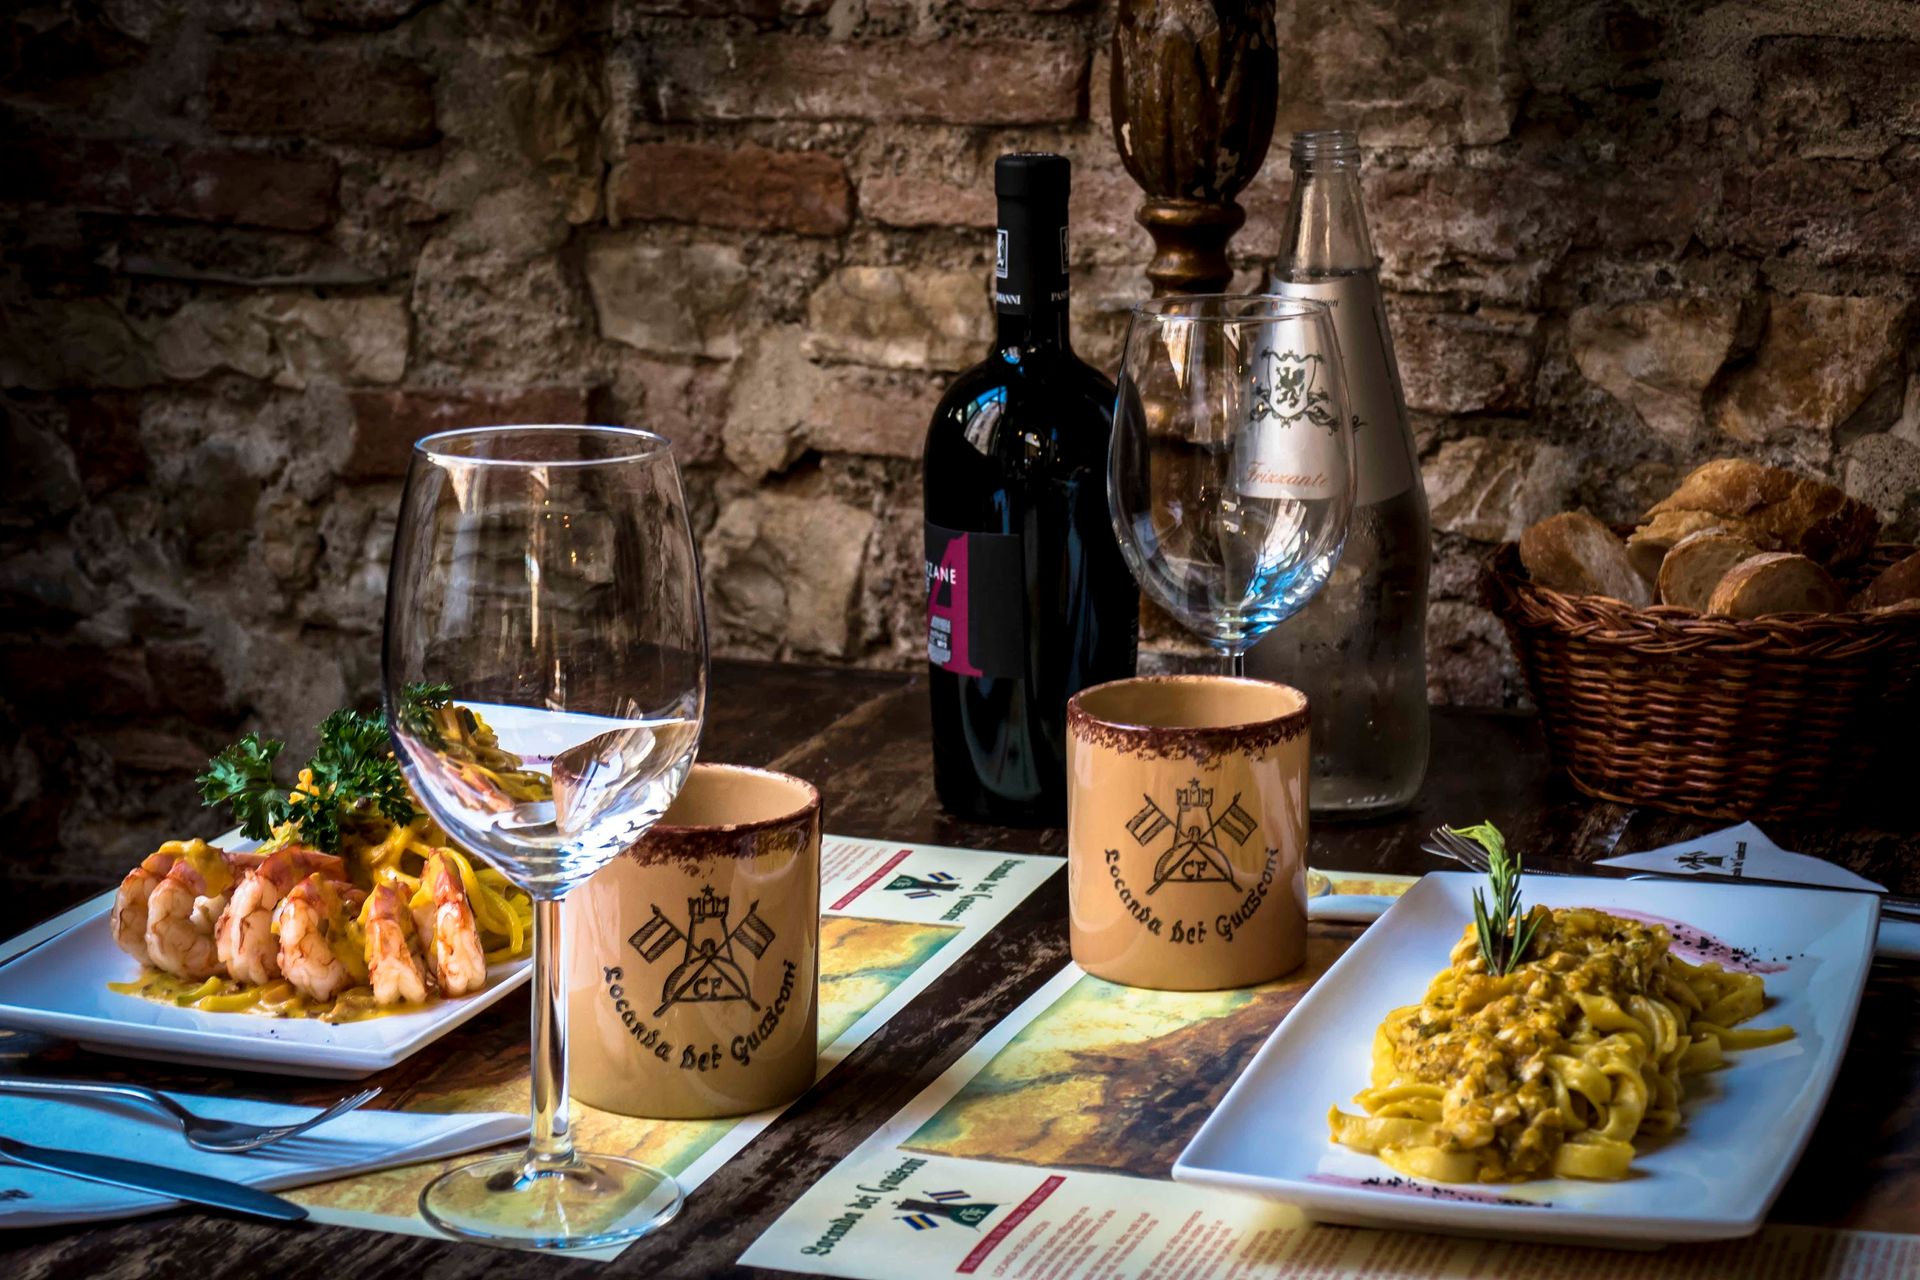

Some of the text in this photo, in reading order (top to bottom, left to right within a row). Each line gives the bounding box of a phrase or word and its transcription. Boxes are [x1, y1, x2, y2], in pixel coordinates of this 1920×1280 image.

[1247, 461, 1329, 488] Frizzante
[1104, 849, 1163, 936] Locanda
[603, 966, 673, 1062] Locanda
